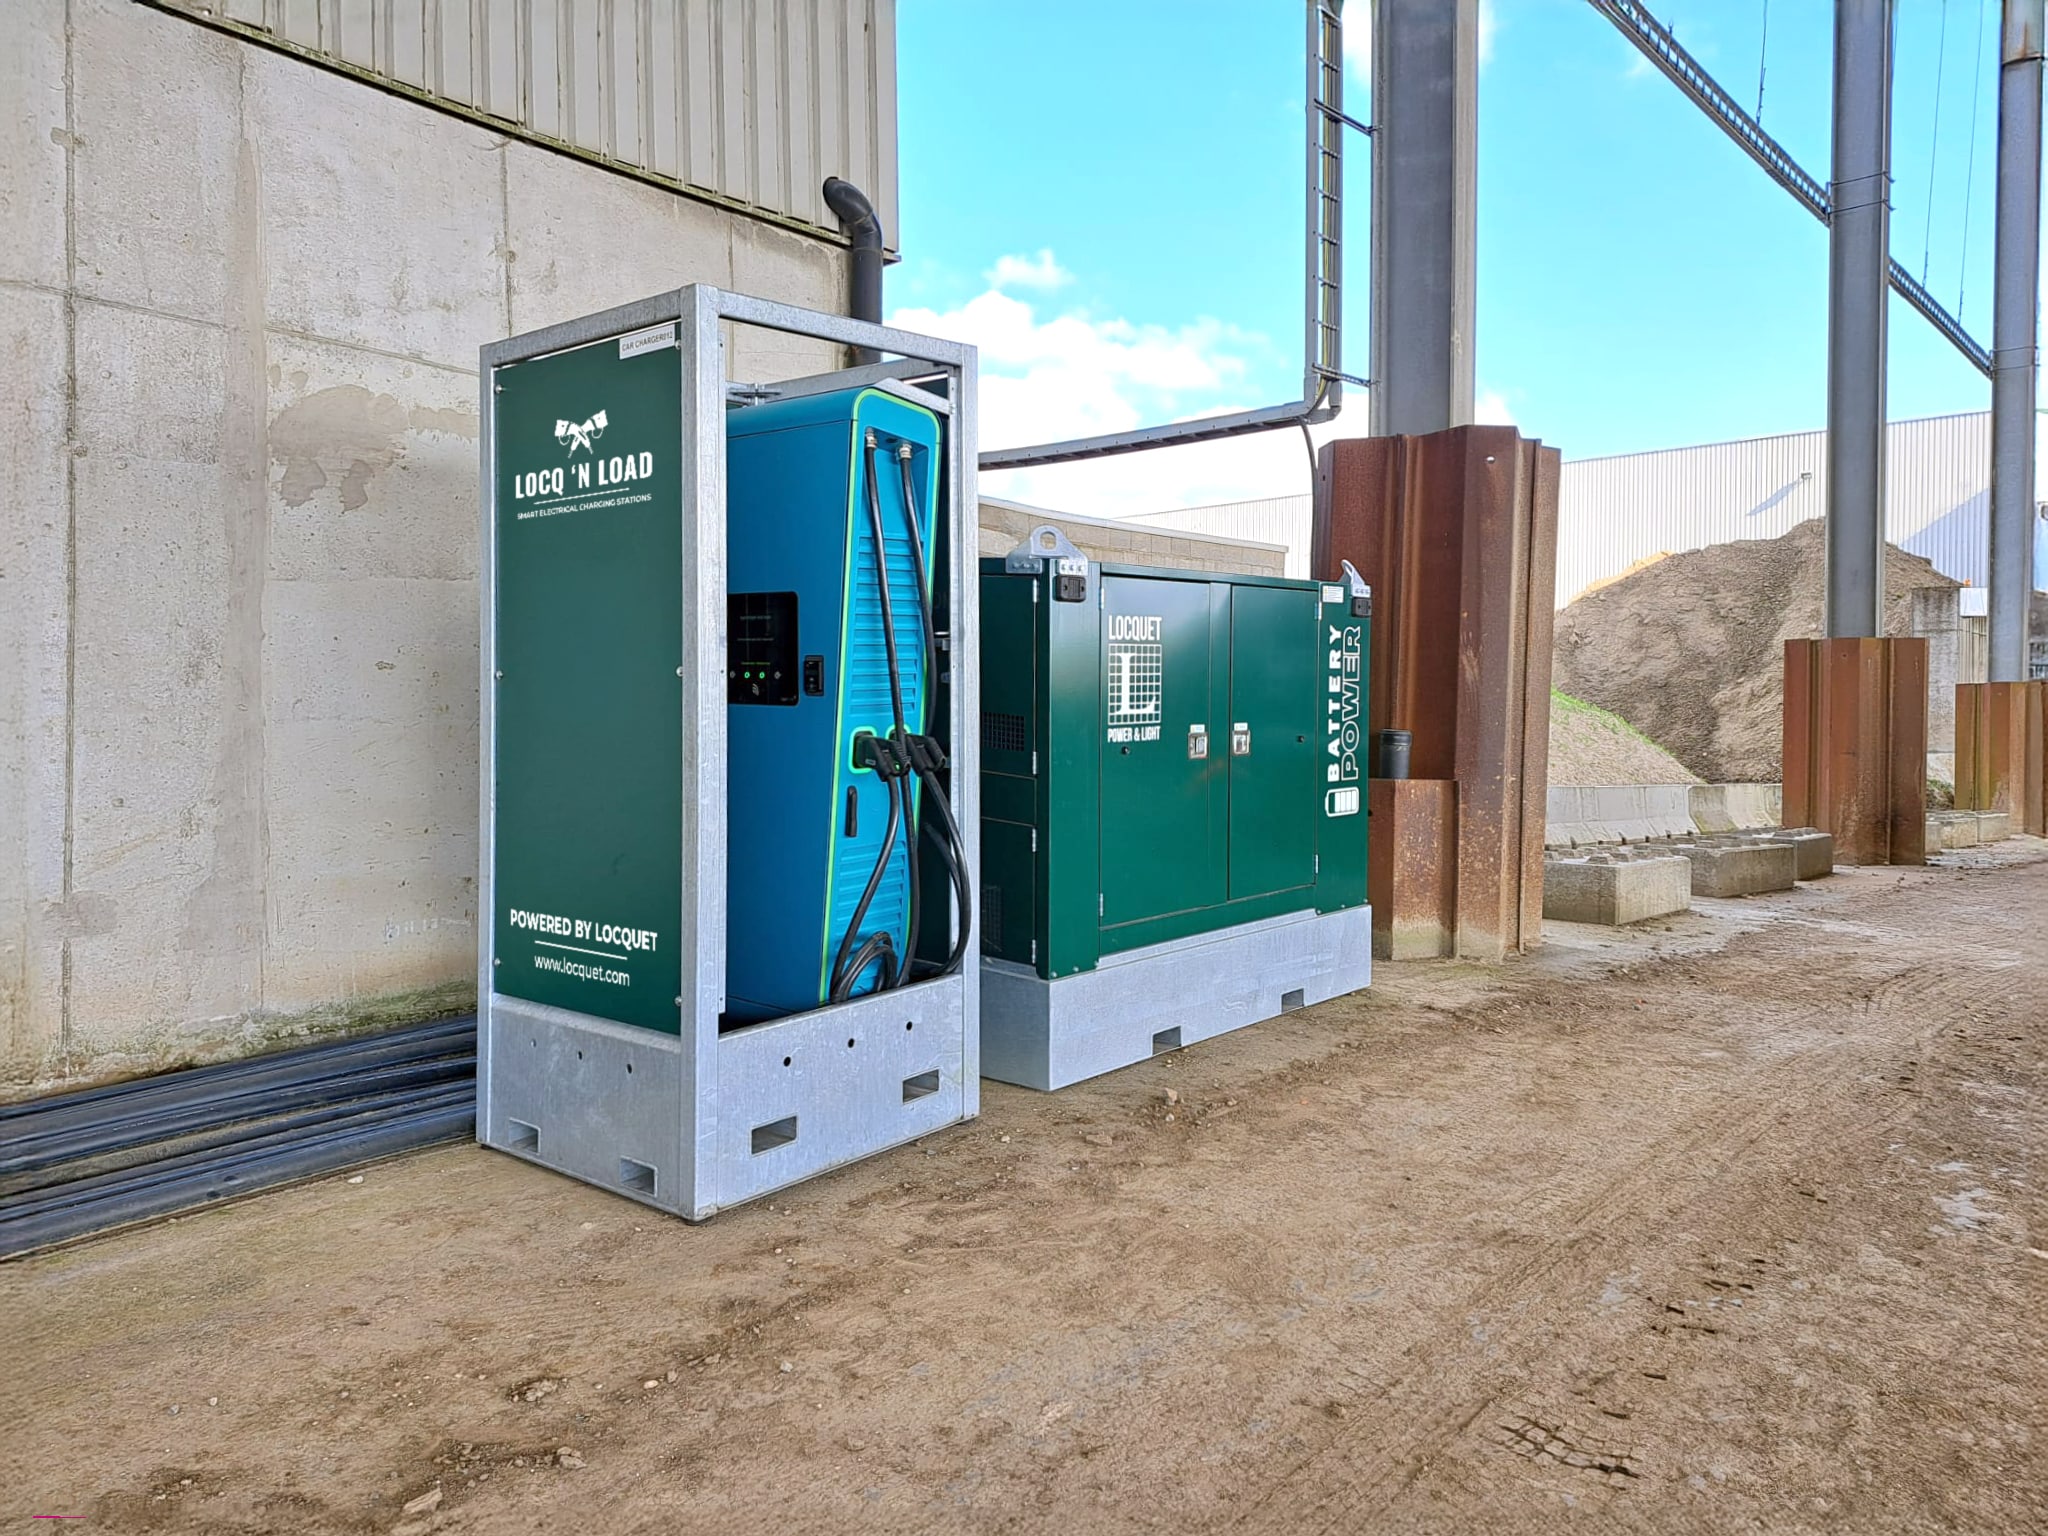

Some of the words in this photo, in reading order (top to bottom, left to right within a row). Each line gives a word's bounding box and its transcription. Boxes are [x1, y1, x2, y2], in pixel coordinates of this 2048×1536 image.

[515, 467, 564, 499] LOCQ
[598, 451, 653, 486] LOAD
[517, 510, 539, 520] SMART
[539, 504, 578, 517] ELECTRICAL
[579, 499, 616, 511] CHARGING
[616, 493, 652, 505] STATIONS
[1108, 615, 1162, 641] LOCQUET
[1328, 624, 1342, 782] BATTERY
[1341, 626, 1361, 781] POWER
[1107, 727, 1133, 742] POWER
[1134, 727, 1141, 740] &
[1141, 726, 1160, 741] LIGHT
[510, 908, 572, 936] POWERED
[575, 919, 592, 940] BY
[595, 922, 658, 952] LOCQUET
[534, 955, 630, 987] www.locquet.com
